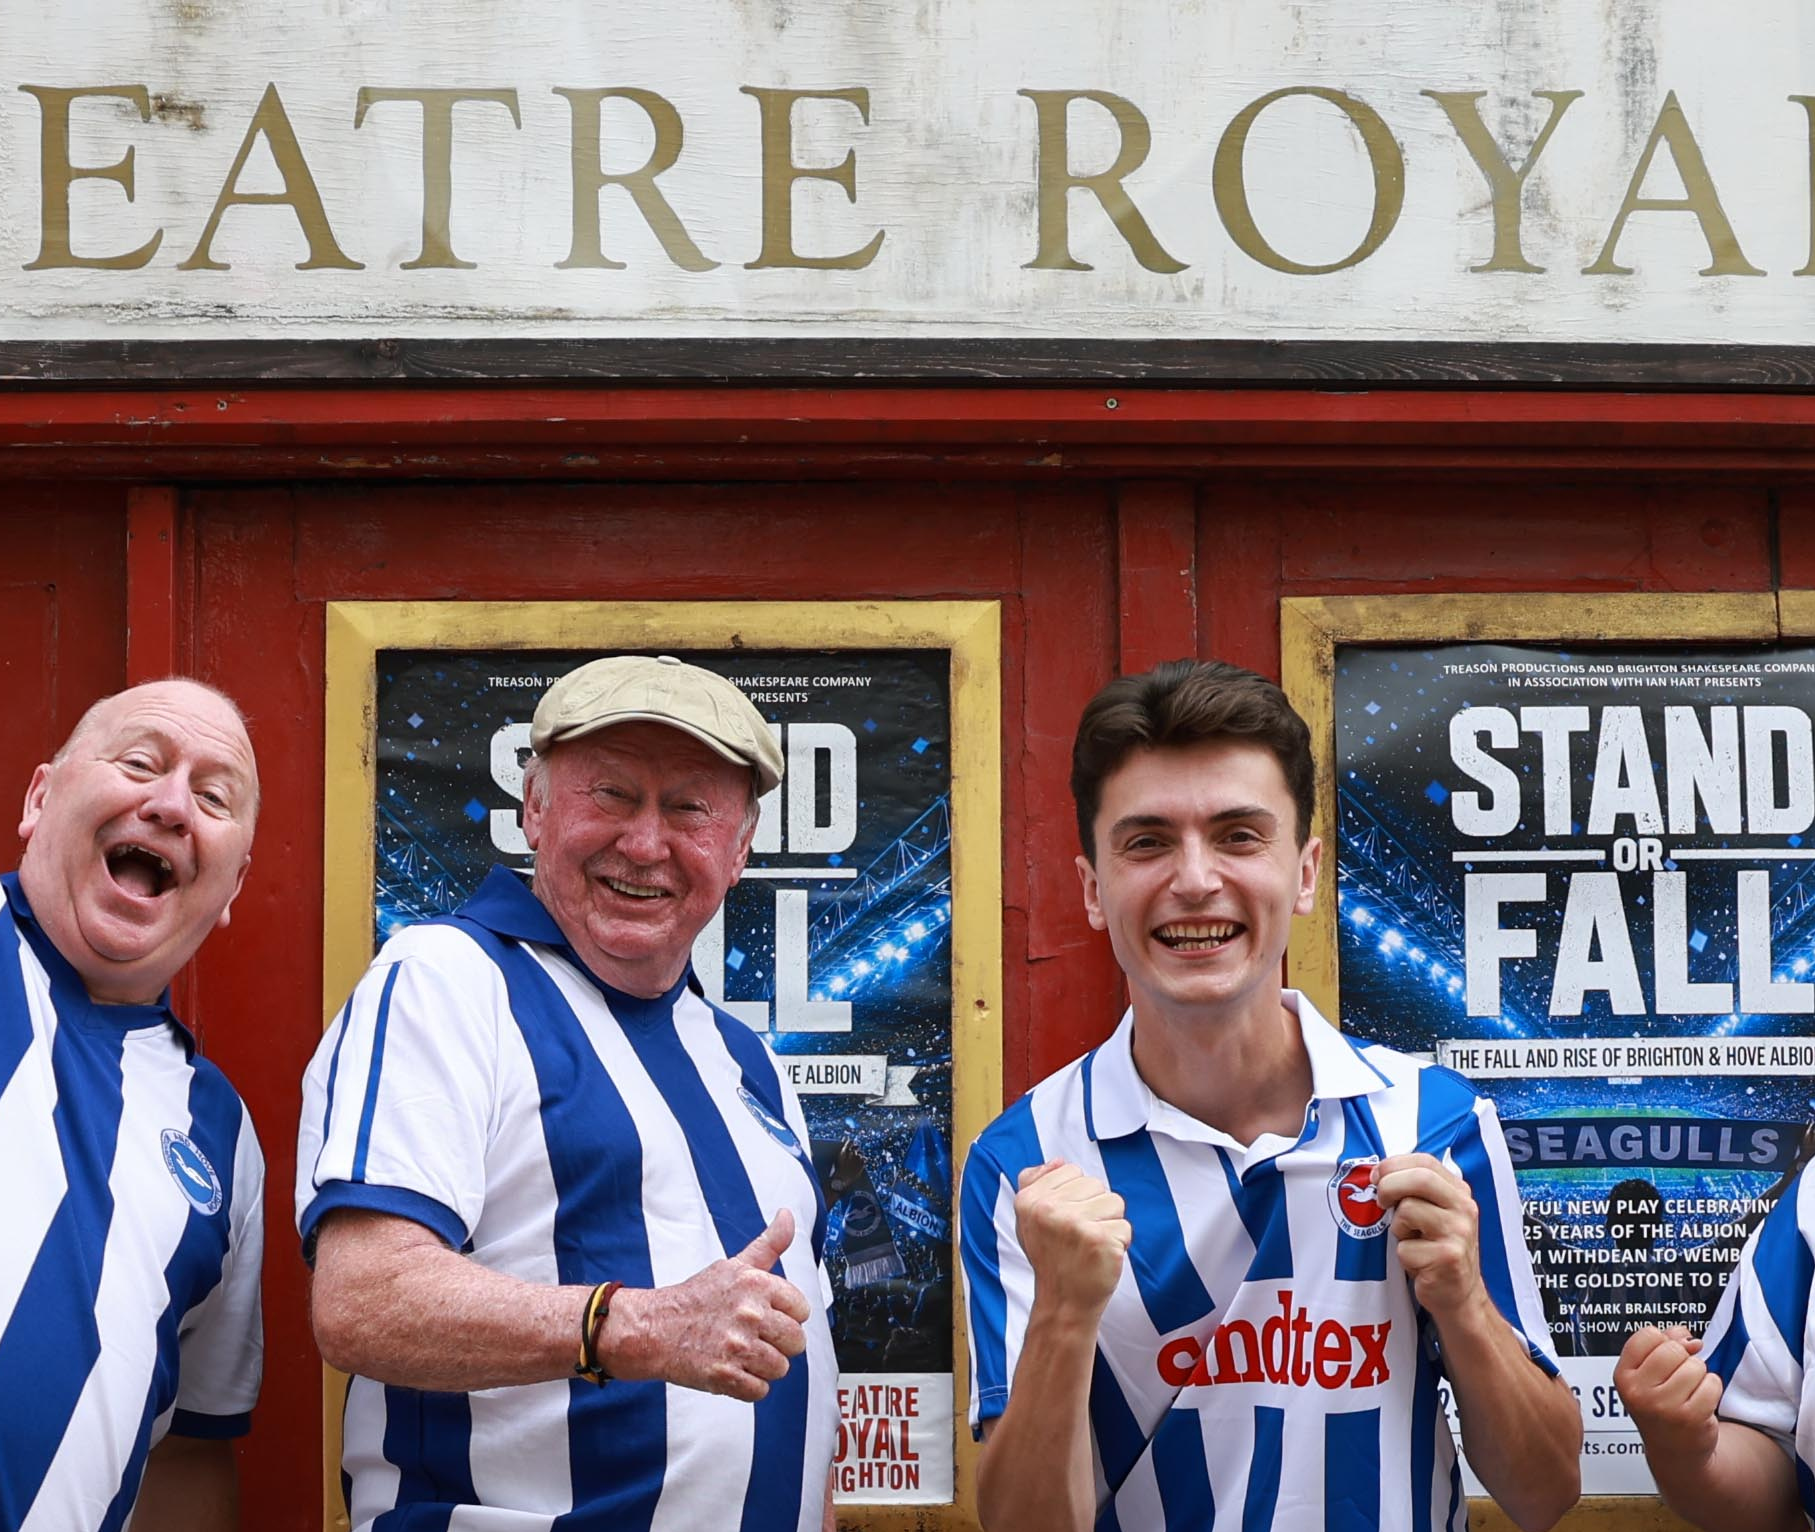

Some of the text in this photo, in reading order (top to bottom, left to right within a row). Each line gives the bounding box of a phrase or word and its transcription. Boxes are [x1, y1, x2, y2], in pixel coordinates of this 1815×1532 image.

[1443, 664, 1498, 675] TREASON
[1501, 663, 1586, 674] PRODUCTIONS
[1588, 664, 1615, 674] AND
[1617, 664, 1678, 675] BRIGHTON
[1681, 664, 1762, 674] SHAKESPEARE
[488, 676, 542, 688] TREASON
[728, 676, 810, 688] SHAKESPEARE
[812, 676, 872, 688] COMPANY
[1508, 677, 1521, 688] IN
[1611, 677, 1643, 688] WITH
[1646, 677, 1667, 688] IAN
[1670, 677, 1701, 688] HART
[1704, 677, 1762, 688] PRESENTS
[750, 691, 809, 703] PRESENTS
[1449, 704, 1815, 837] STAND
[1612, 836, 1664, 872] OR
[1464, 870, 1815, 1017] FALL
[1450, 1050, 1480, 1069] THE
[1484, 1049, 1521, 1069] FALL
[1525, 1048, 1557, 1068] AND
[1563, 1048, 1597, 1068] RISE
[1602, 1048, 1622, 1067] OF
[1626, 1046, 1704, 1067] BRIGHTON
[1708, 1047, 1723, 1066] &
[1726, 1046, 1766, 1066] HOVE
[805, 1064, 862, 1085] ALBION
[1505, 1125, 1780, 1164] SEAGULLS
[895, 1201, 940, 1230] ALBION
[1567, 1200, 1611, 1215] NEW
[1616, 1199, 1659, 1215] PLAY
[1339, 1218, 1386, 1237] THE SEAGULLS
[1548, 1225, 1605, 1240] YEARS
[1610, 1224, 1634, 1239] OF
[1640, 1224, 1674, 1239] THE
[1548, 1249, 1647, 1264] WITHDEAN
[1653, 1249, 1677, 1264] TO
[1683, 1248, 1740, 1263] WEMB
[1536, 1274, 1568, 1289] THE
[1574, 1273, 1684, 1288] GOLDSTONE
[1689, 1272, 1713, 1287] TO
[1559, 1302, 1707, 1316] BY MARK BRAILSFORD
[1578, 1321, 1620, 1333] SHOW
[837, 1385, 919, 1419] EATRE
[1592, 1386, 1630, 1418] SE
[834, 1418, 919, 1464] OYAL
